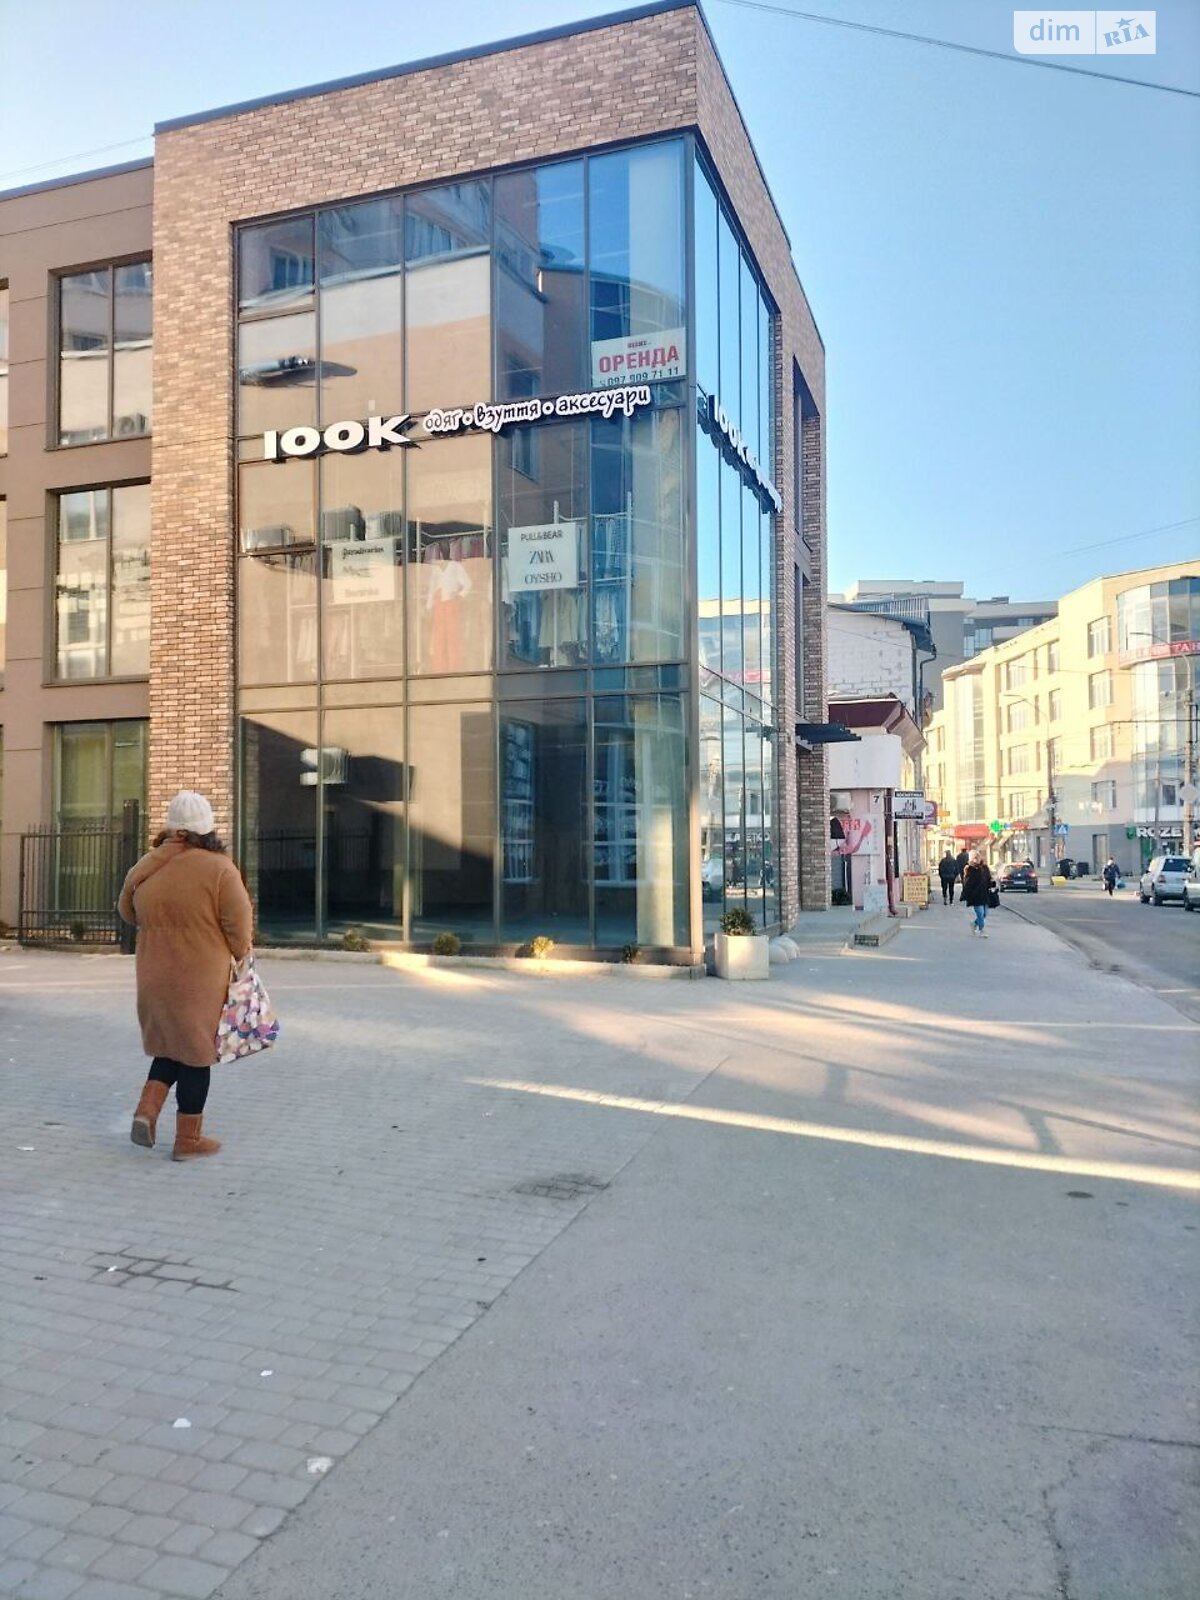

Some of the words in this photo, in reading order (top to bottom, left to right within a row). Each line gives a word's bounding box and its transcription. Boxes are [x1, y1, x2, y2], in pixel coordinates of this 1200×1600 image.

[598, 345, 680, 373] ОРЕНДА
[424, 410, 460, 431] одяг
[475, 402, 540, 431] взуття
[556, 386, 650, 416] аксесуари
[525, 571, 562, 584] OYSHO
[873, 795, 880, 803] 7
